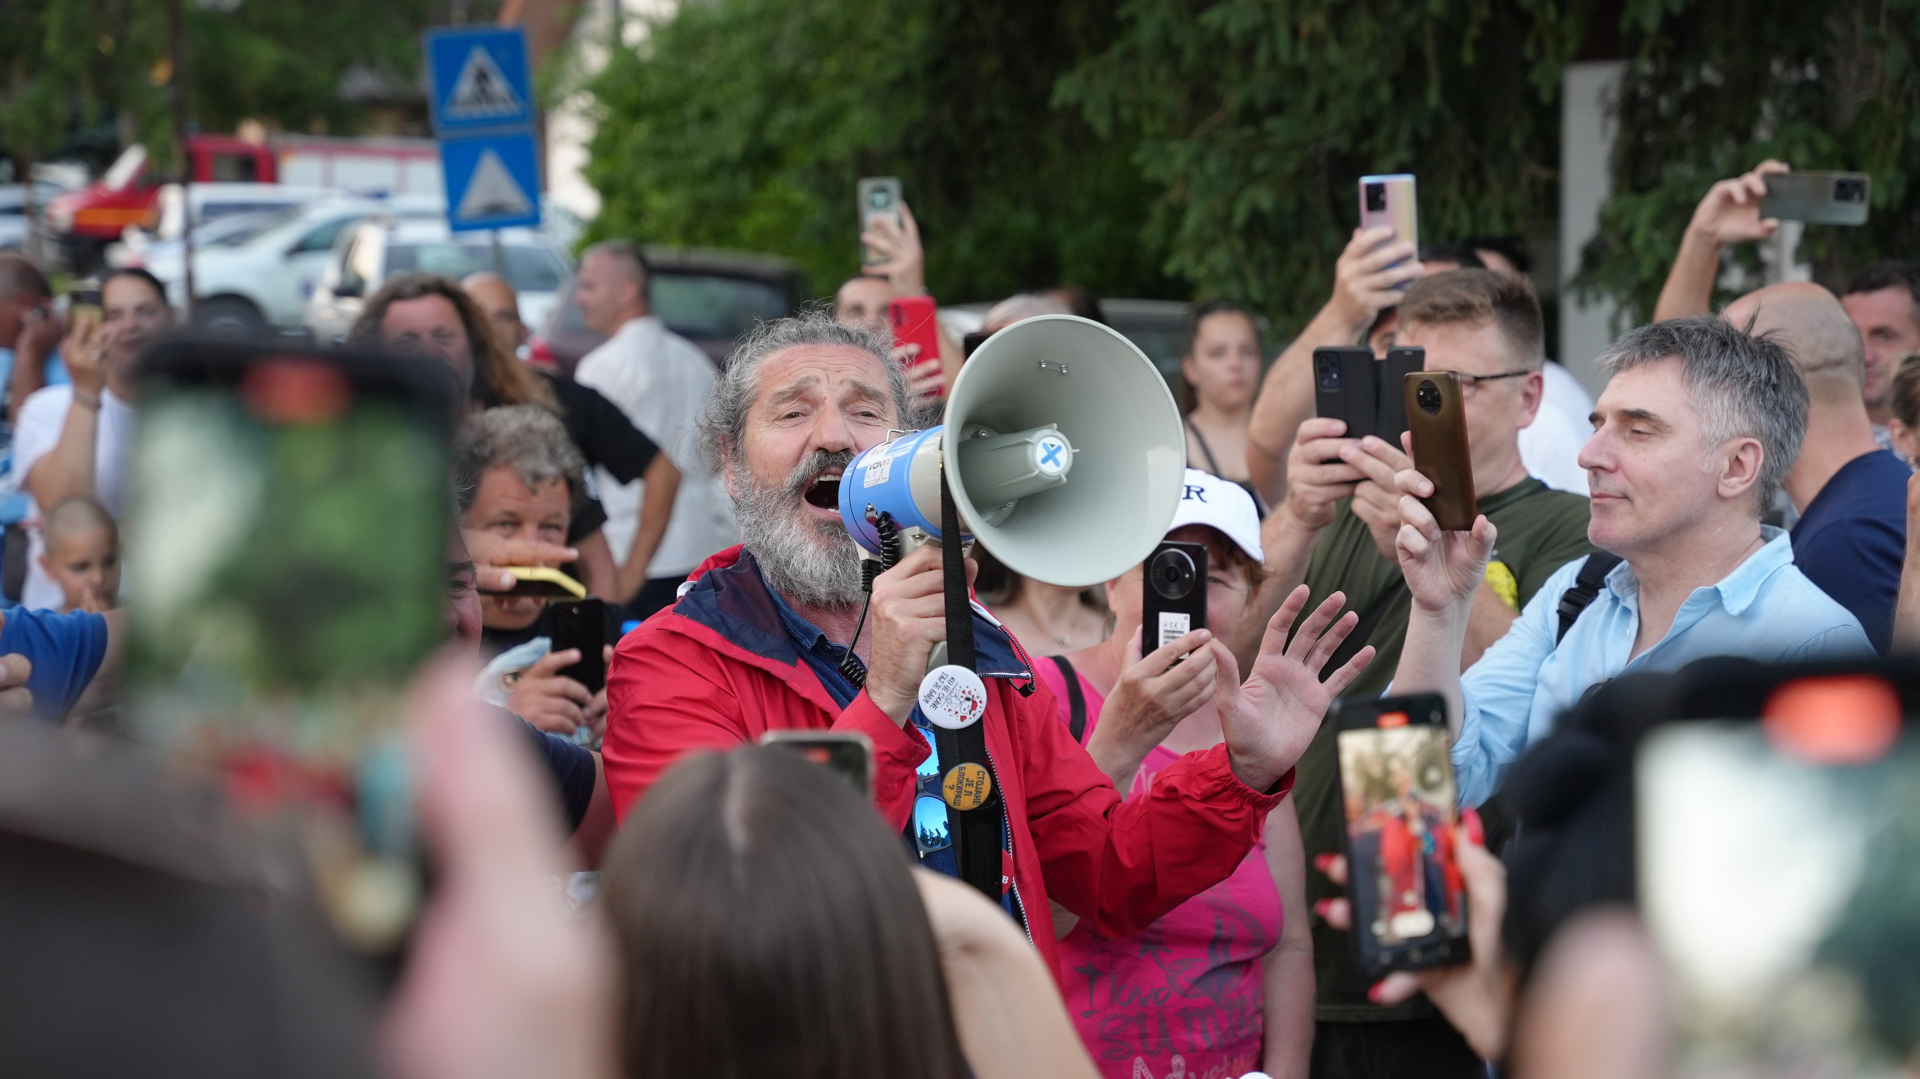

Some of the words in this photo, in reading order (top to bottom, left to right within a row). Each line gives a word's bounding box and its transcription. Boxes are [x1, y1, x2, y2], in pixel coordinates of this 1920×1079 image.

[953, 766, 966, 806] БЛОКИРАШ
[965, 777, 974, 788] ЈЕ
[972, 770, 986, 805] СТОЈАНЕ
[1073, 962, 1102, 1018] I
[1110, 973, 1172, 1009] love
